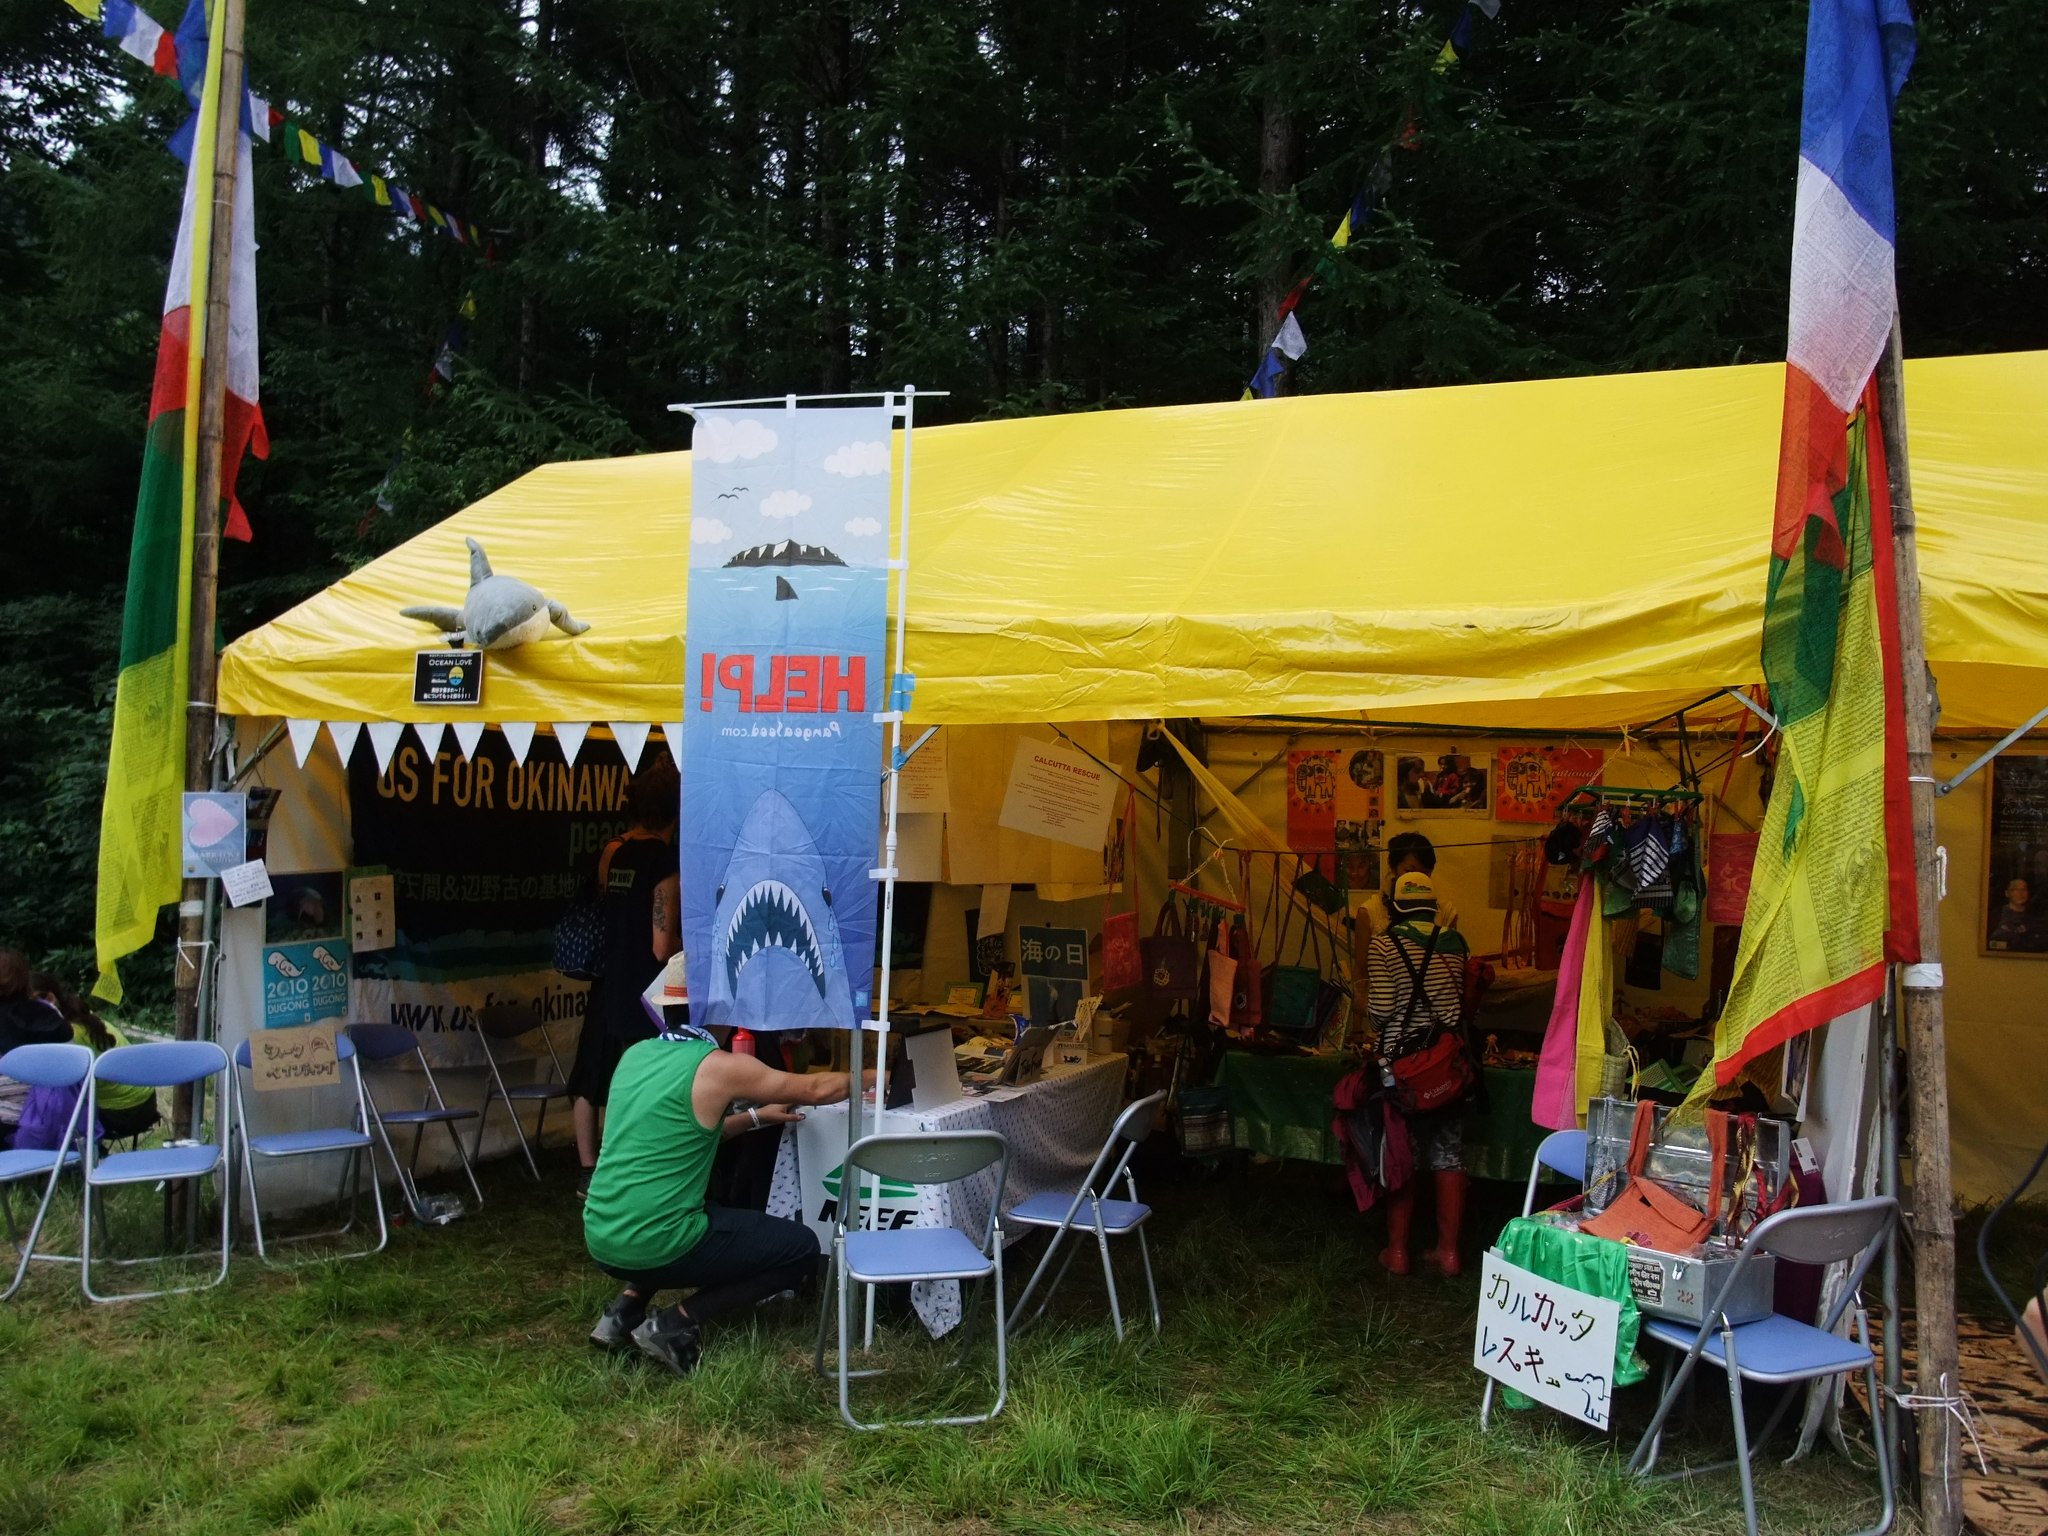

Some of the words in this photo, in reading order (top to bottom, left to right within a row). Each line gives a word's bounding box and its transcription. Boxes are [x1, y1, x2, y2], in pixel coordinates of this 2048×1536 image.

[376, 746, 419, 803] US
[432, 751, 496, 810] FOR
[1034, 755, 1071, 773] CALCUTTA
[1072, 766, 1101, 781] RESCUE
[1021, 938, 1084, 965] 海の日
[267, 978, 308, 999] 2010
[312, 972, 346, 991] 2010
[267, 999, 310, 1015] DUGONG
[312, 992, 346, 1007] DUGONG
[1487, 1273, 1595, 1341] カルカッタ
